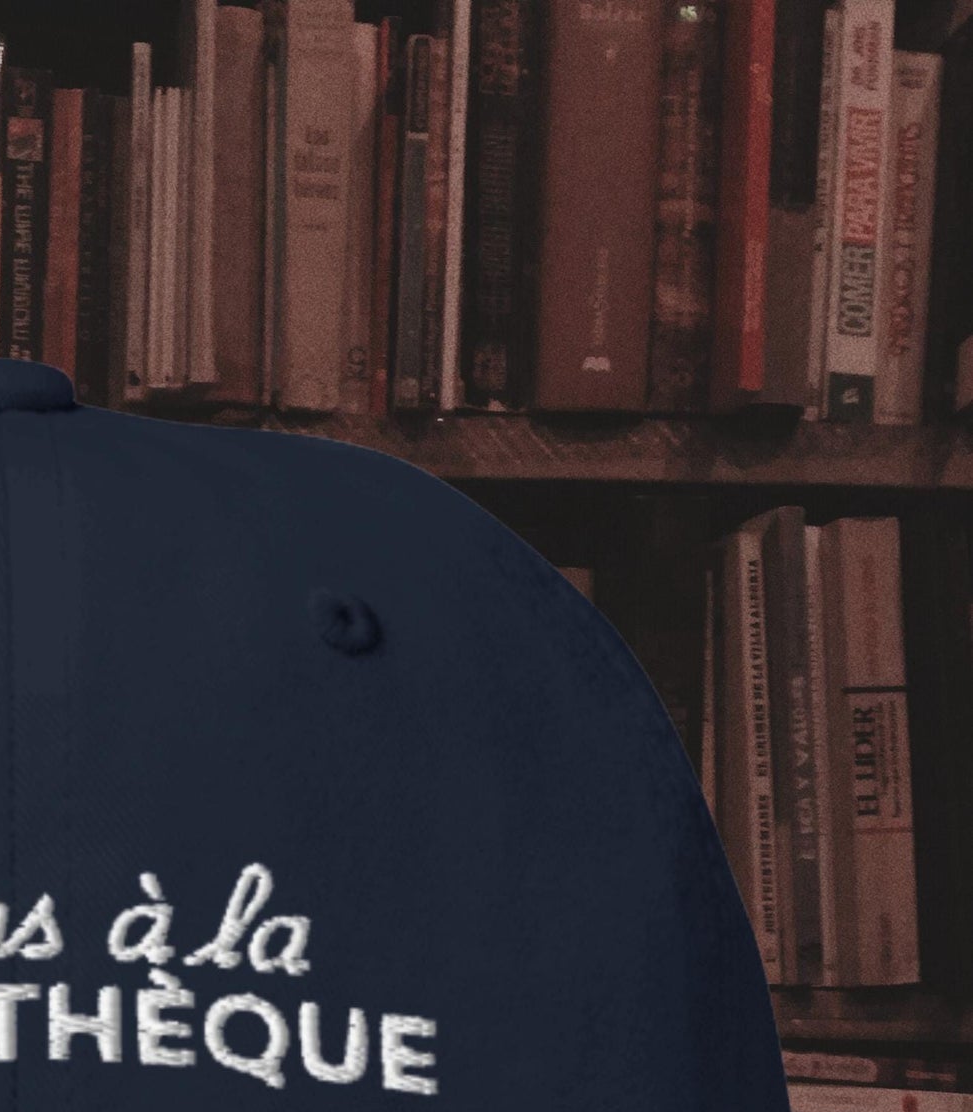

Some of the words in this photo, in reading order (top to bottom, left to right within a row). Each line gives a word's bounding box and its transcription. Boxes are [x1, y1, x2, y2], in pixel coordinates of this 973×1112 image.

[843, 177, 876, 242] PARA
[841, 247, 874, 337] COMER
[107, 872, 174, 966] à
[182, 862, 311, 976] la
